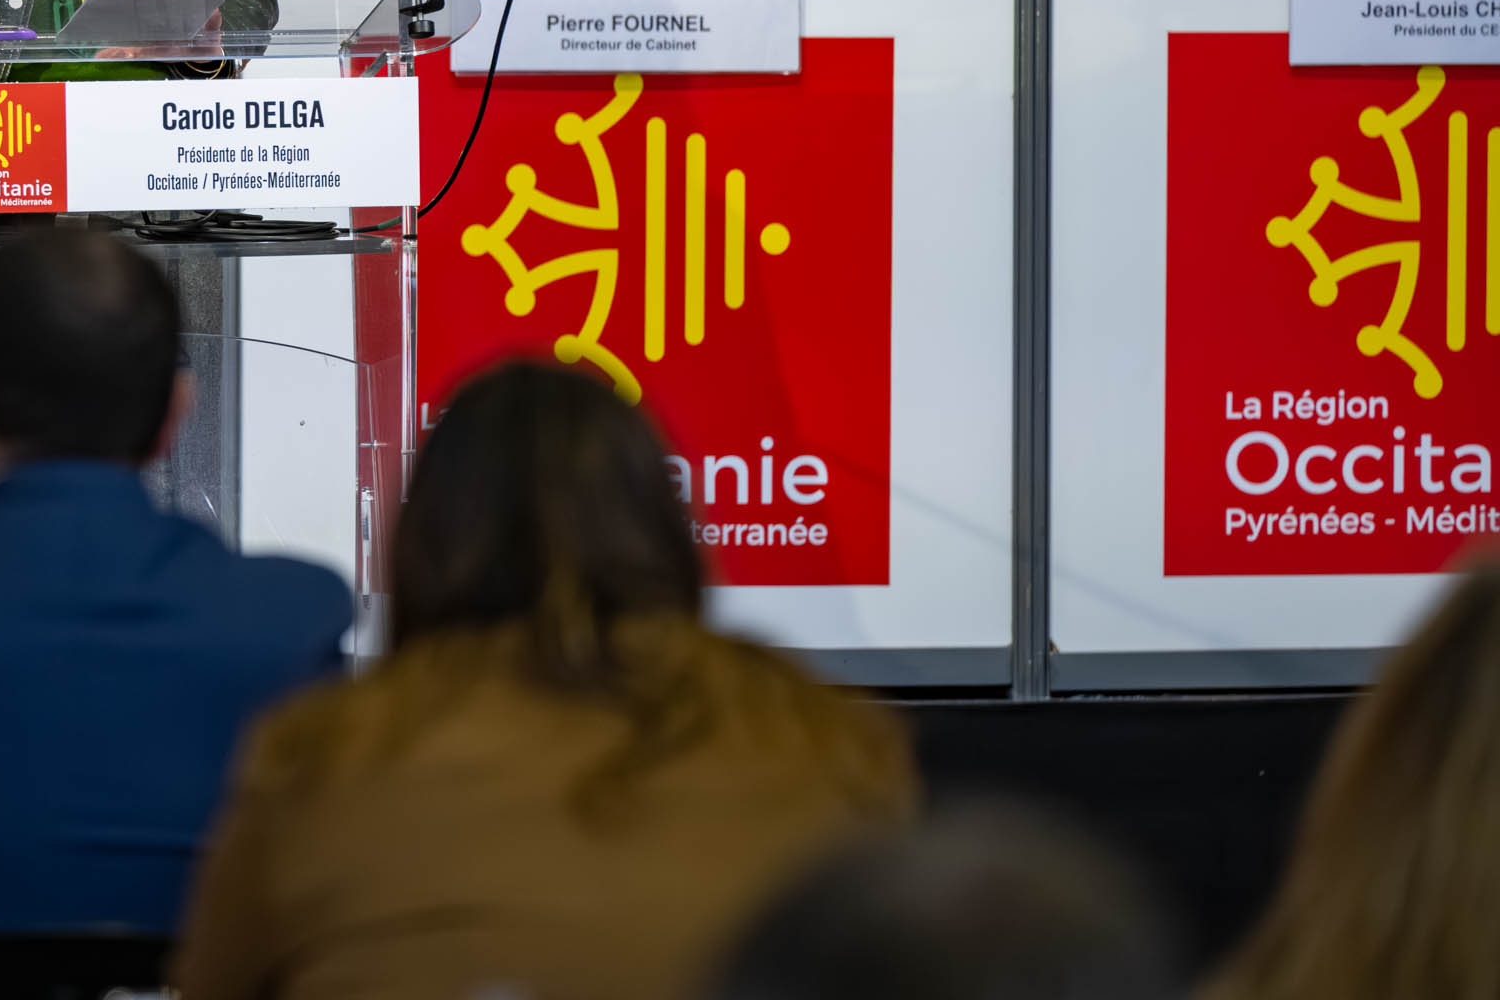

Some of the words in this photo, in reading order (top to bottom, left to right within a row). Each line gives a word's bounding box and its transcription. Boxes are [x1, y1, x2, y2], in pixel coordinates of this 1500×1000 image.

[1361, 0, 1468, 18] Jean-Louis
[547, 15, 605, 32] Pierre
[612, 15, 711, 32] FOURNEL
[1394, 23, 1456, 37] Président
[1460, 23, 1476, 36] du
[561, 38, 621, 51] Directeur
[626, 38, 641, 51] de
[646, 38, 696, 51] Cabinet
[162, 101, 235, 131] Carole
[245, 100, 325, 129] DELGA
[177, 146, 236, 163] Présidente
[241, 145, 253, 162] de
[258, 145, 268, 162] la
[273, 145, 310, 165] Région
[147, 172, 198, 191] Occitanie
[212, 171, 341, 192] Pyrénées-Méditerranée
[0, 198, 53, 206] Méditerranée
[1225, 391, 1262, 419] La
[1272, 389, 1389, 425] Région
[1225, 425, 1492, 495] Occita
[1225, 506, 1376, 542] Pyrénées
